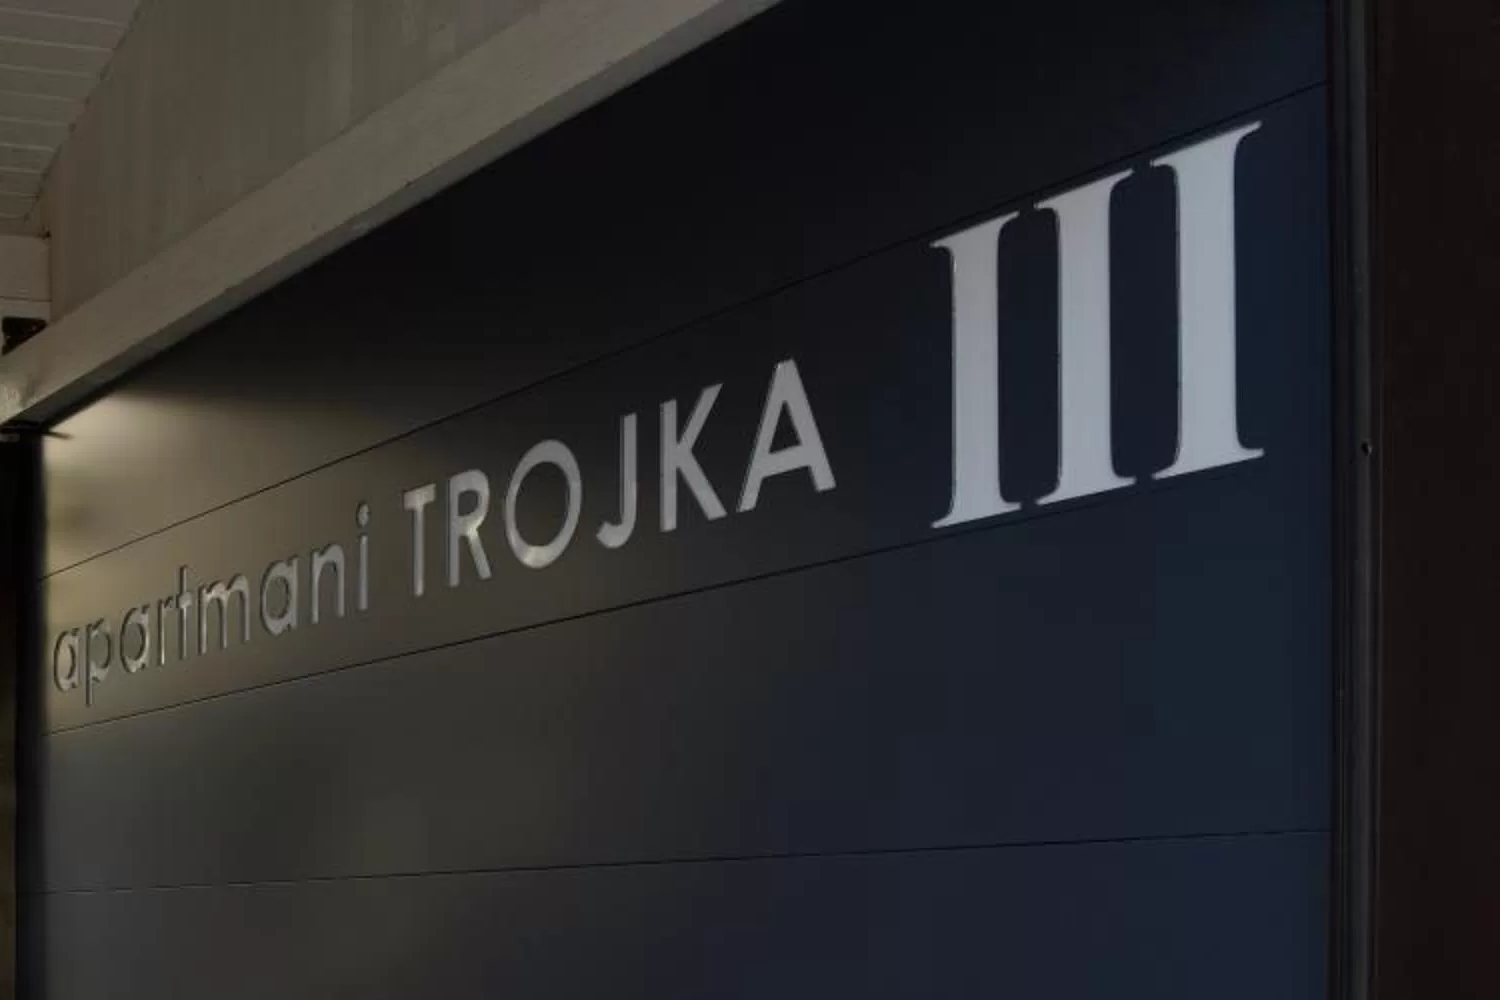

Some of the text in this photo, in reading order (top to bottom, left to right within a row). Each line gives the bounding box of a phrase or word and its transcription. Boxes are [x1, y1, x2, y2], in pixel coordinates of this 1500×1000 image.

[53, 121, 1264, 706] apartmani TROJKA III
